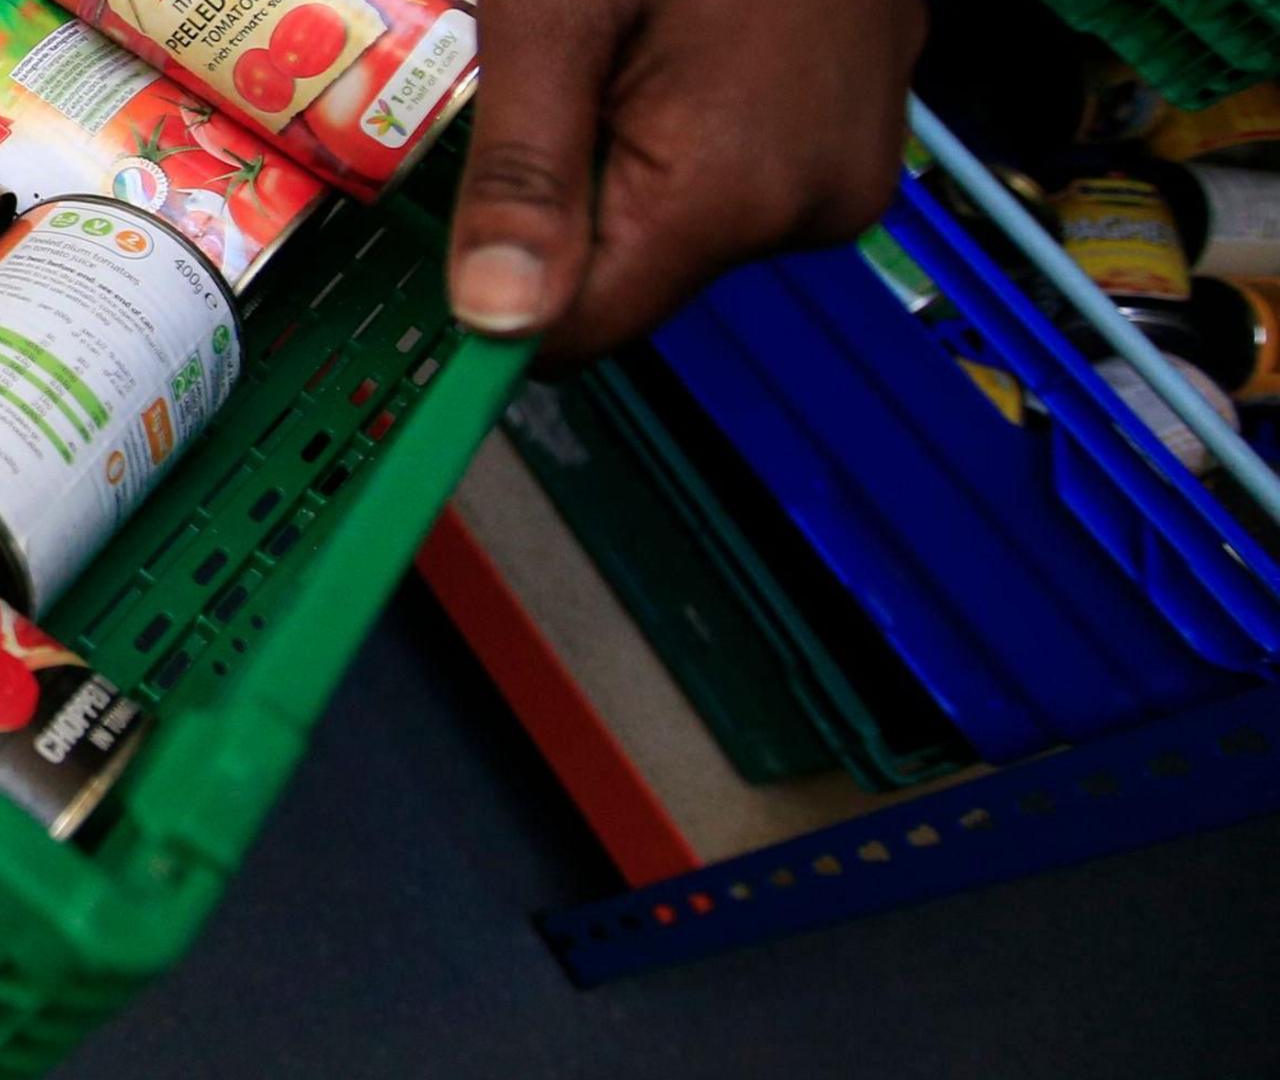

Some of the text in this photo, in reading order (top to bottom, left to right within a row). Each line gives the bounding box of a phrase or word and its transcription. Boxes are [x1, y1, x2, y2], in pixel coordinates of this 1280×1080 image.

[212, 45, 232, 66] rich
[390, 28, 458, 107] 1 of 5 a day
[173, 256, 204, 296] 400g
